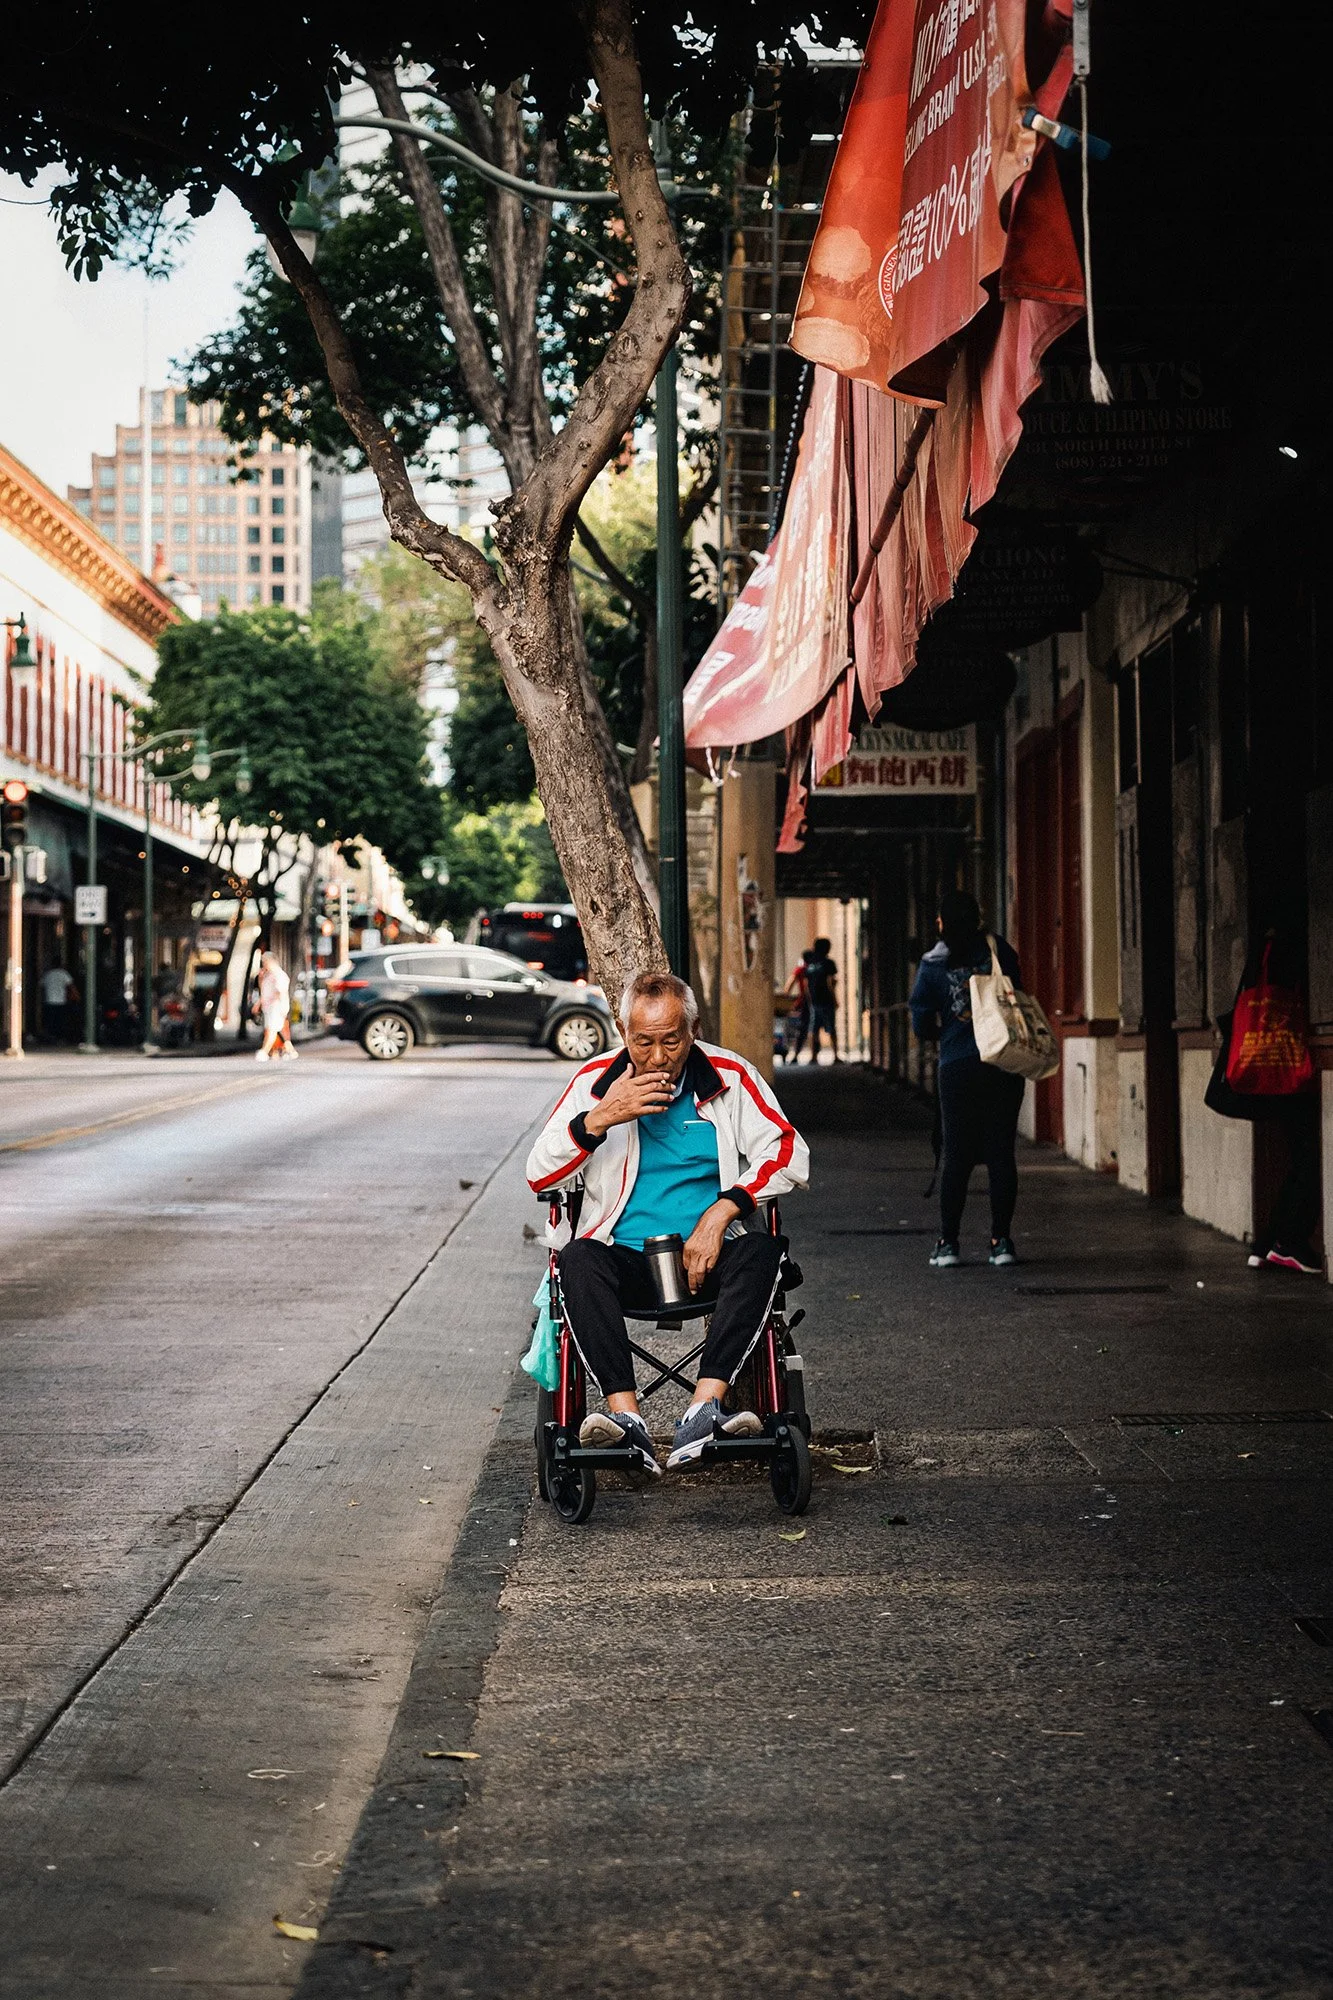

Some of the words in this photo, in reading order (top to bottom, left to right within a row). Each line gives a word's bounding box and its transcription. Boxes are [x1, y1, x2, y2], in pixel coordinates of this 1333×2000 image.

[883, 252, 898, 291] GINSEN
[1044, 360, 1204, 403] IMMY'S
[1175, 405, 1232, 430] STORE
